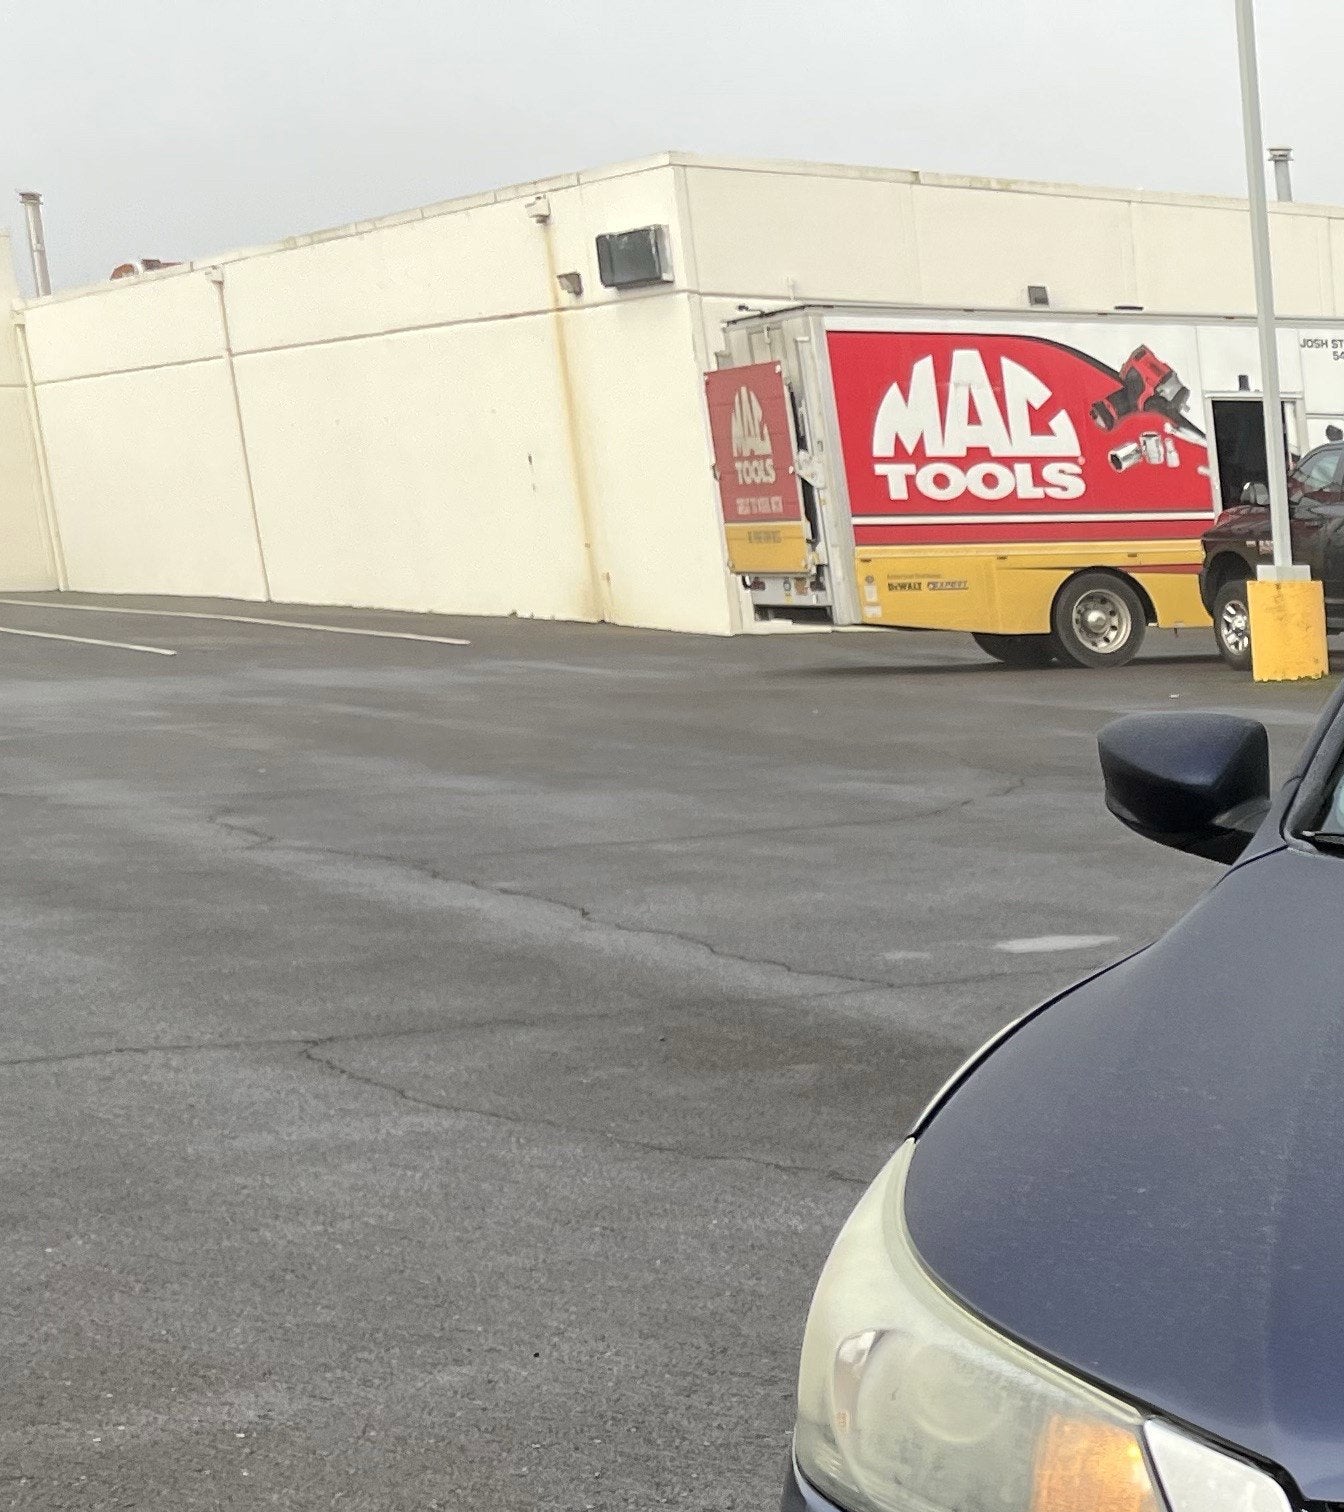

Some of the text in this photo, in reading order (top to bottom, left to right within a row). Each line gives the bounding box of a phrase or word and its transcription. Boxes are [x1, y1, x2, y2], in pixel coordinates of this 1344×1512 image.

[1300, 338, 1328, 348] JOSH
[872, 349, 1082, 457] MAC
[735, 459, 776, 485] TOOLS
[873, 461, 1086, 500] TOOLS
